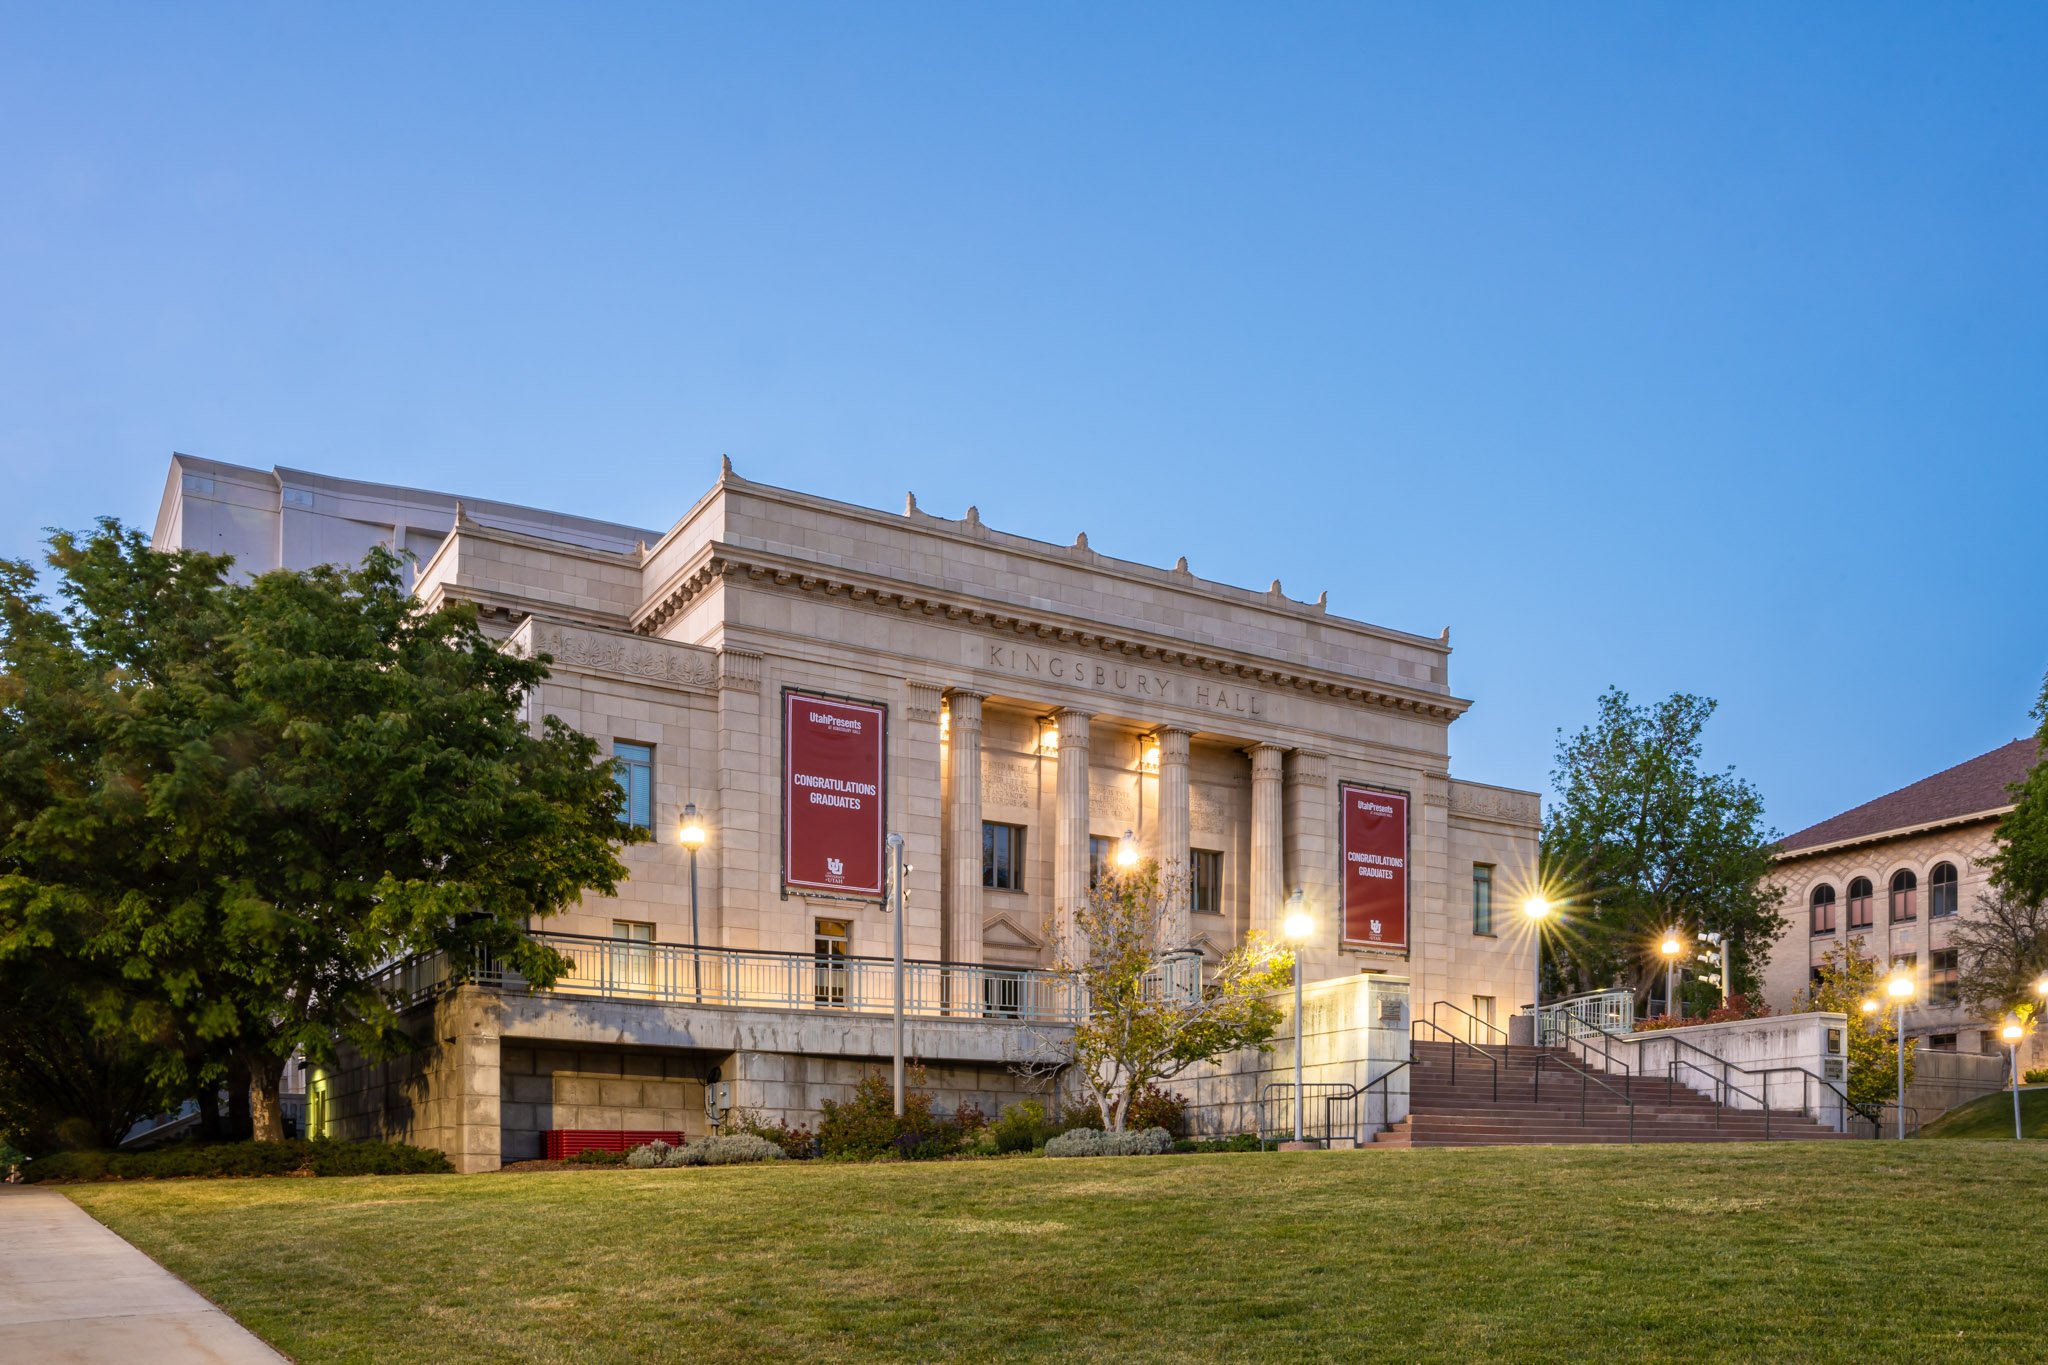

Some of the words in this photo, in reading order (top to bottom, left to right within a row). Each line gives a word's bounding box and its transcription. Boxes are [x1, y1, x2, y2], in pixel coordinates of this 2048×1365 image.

[990, 645, 1170, 697] KINGSBURY
[1196, 686, 1260, 715] HALL
[809, 711, 862, 730] UtahPresents
[794, 773, 876, 796] CONGRATULATIONS
[810, 792, 861, 810] GRADUATES
[1357, 800, 1393, 814] UtahPresents
[1348, 851, 1404, 868] CONGRATULATIONS
[1358, 866, 1394, 880] GRADUATES
